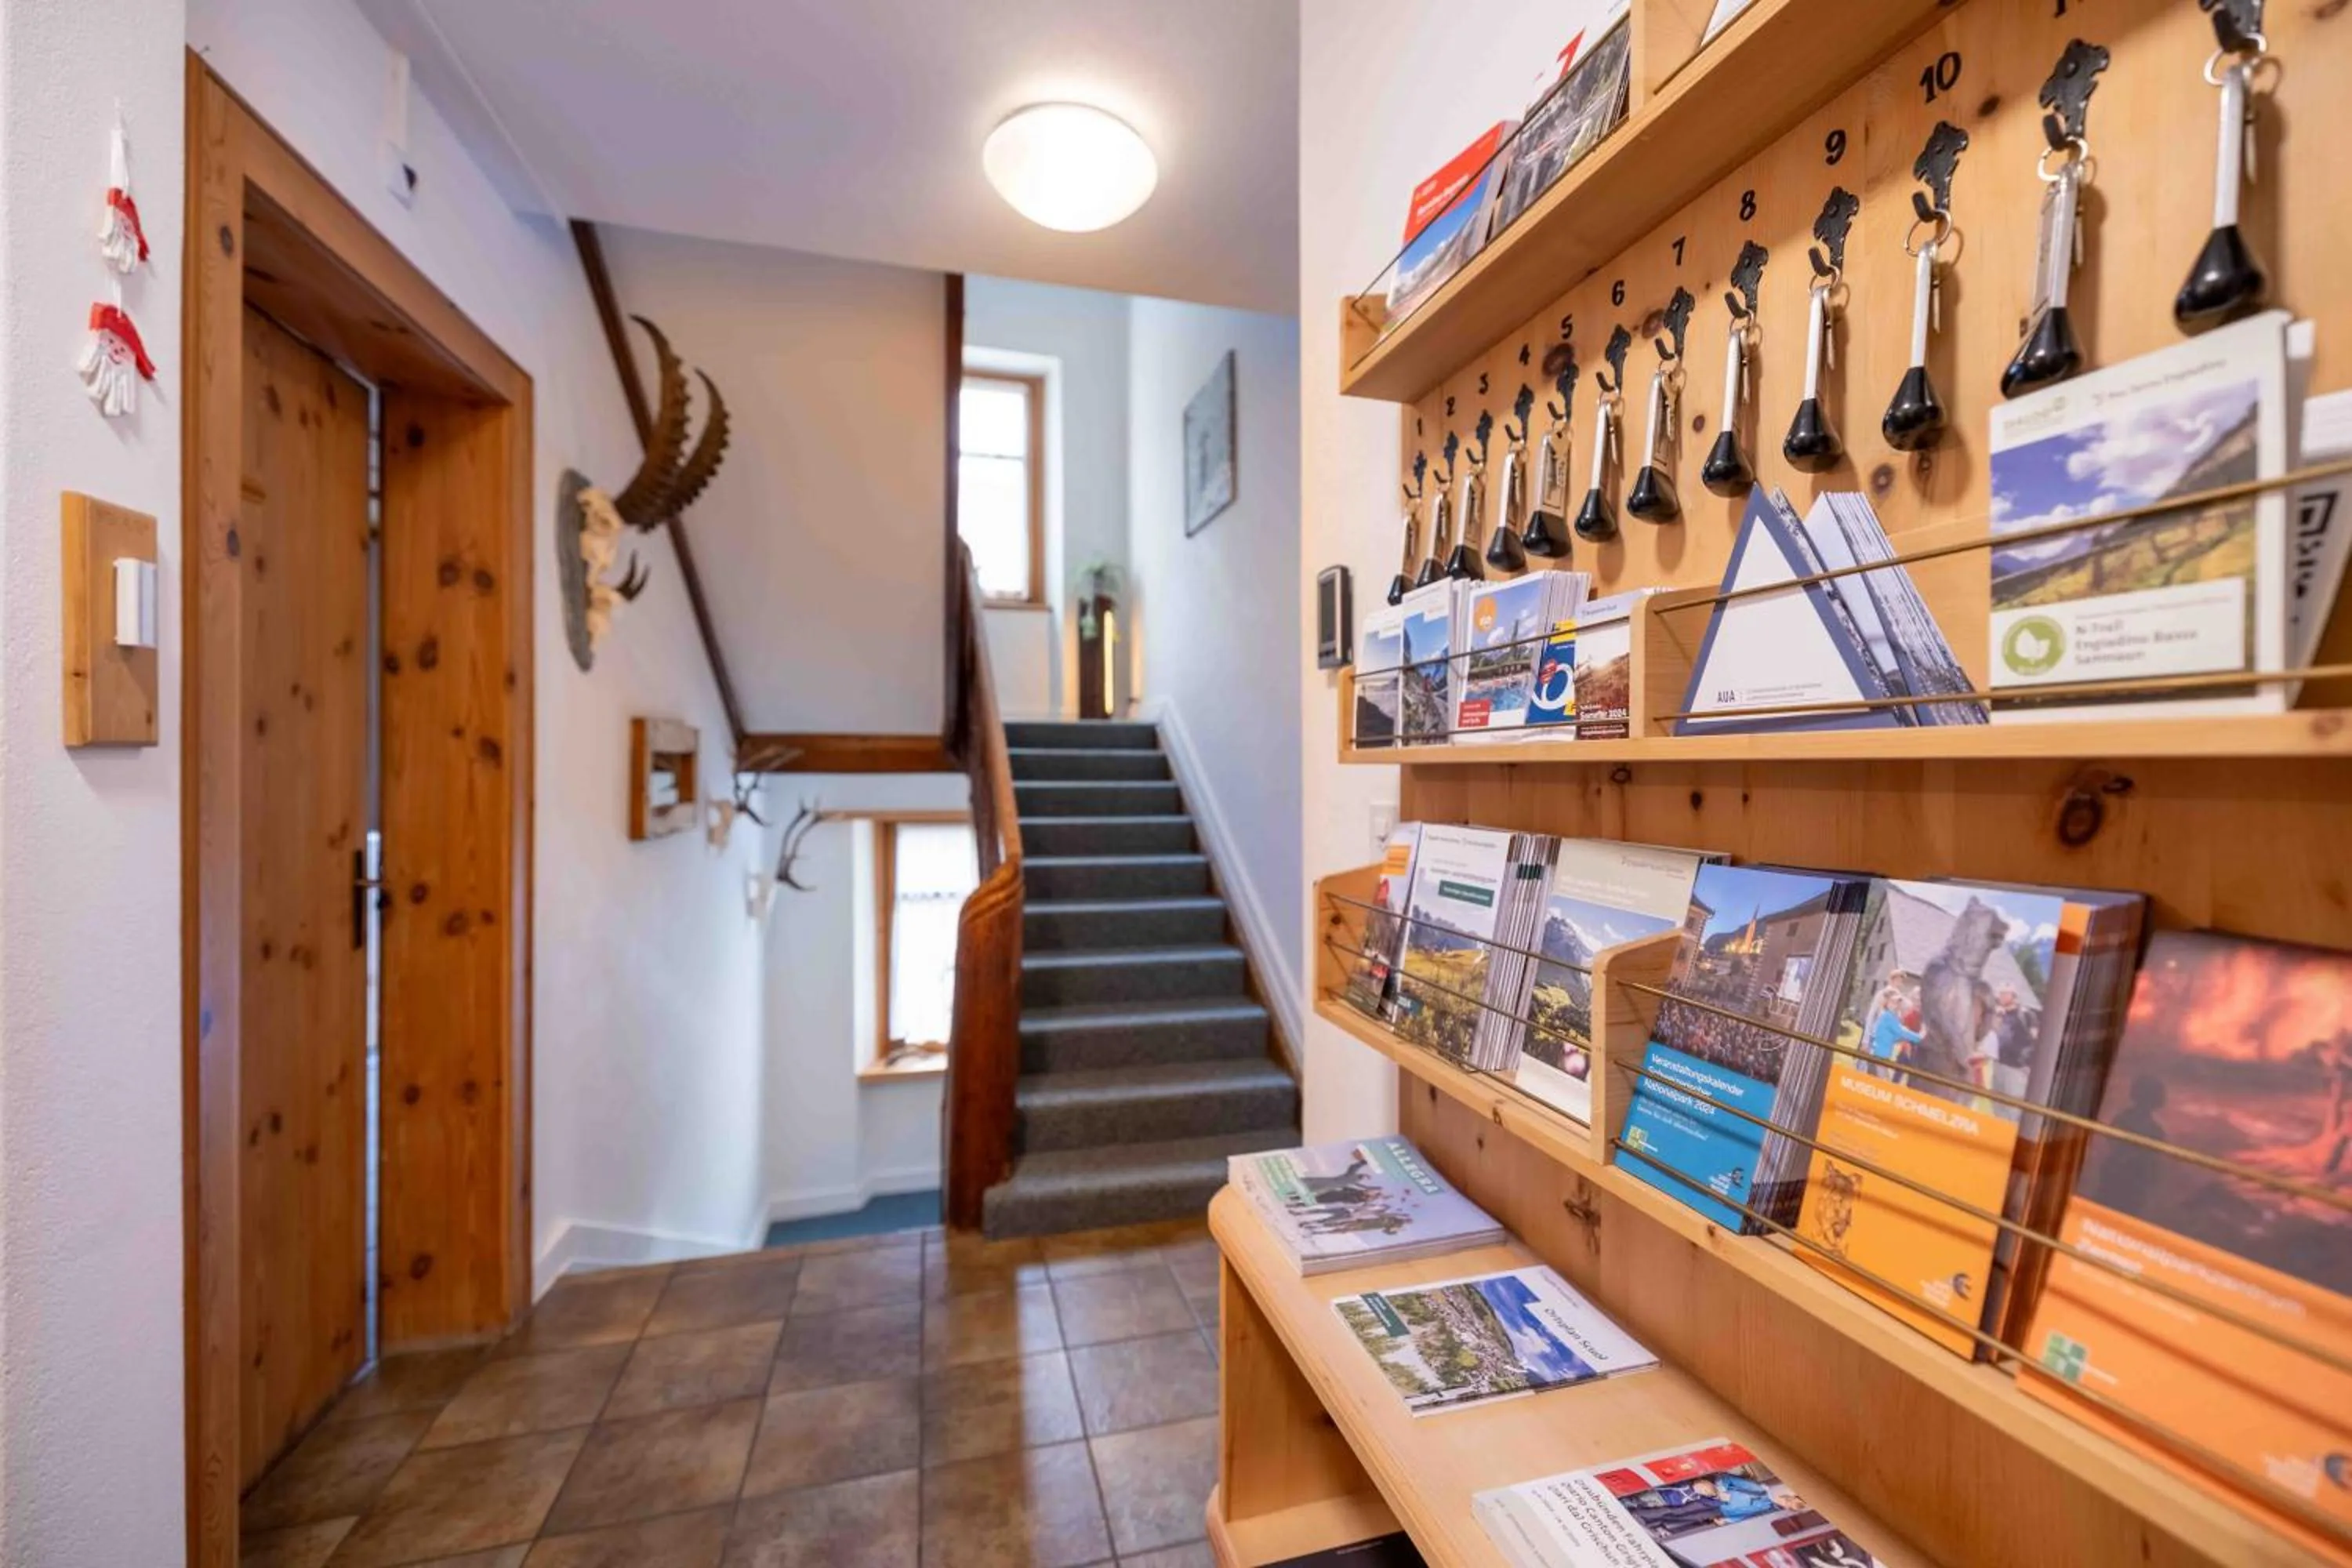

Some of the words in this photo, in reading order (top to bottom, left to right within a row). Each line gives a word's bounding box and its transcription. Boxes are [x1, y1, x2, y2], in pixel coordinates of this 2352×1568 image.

[1918, 51, 1962, 103] 10
[1824, 129, 1847, 165] 9
[1739, 190, 1757, 222] 8
[1671, 236, 1686, 267] 7
[1611, 280, 1625, 307] 6
[1561, 314, 1573, 339] 5
[1519, 343, 1530, 366] 4
[1479, 372, 1489, 394] 3
[1446, 395, 1456, 417] 2
[1417, 417, 1422, 436] 1
[1717, 689, 1735, 703] AUA
[1386, 1142, 1439, 1192] ALLEGRA
